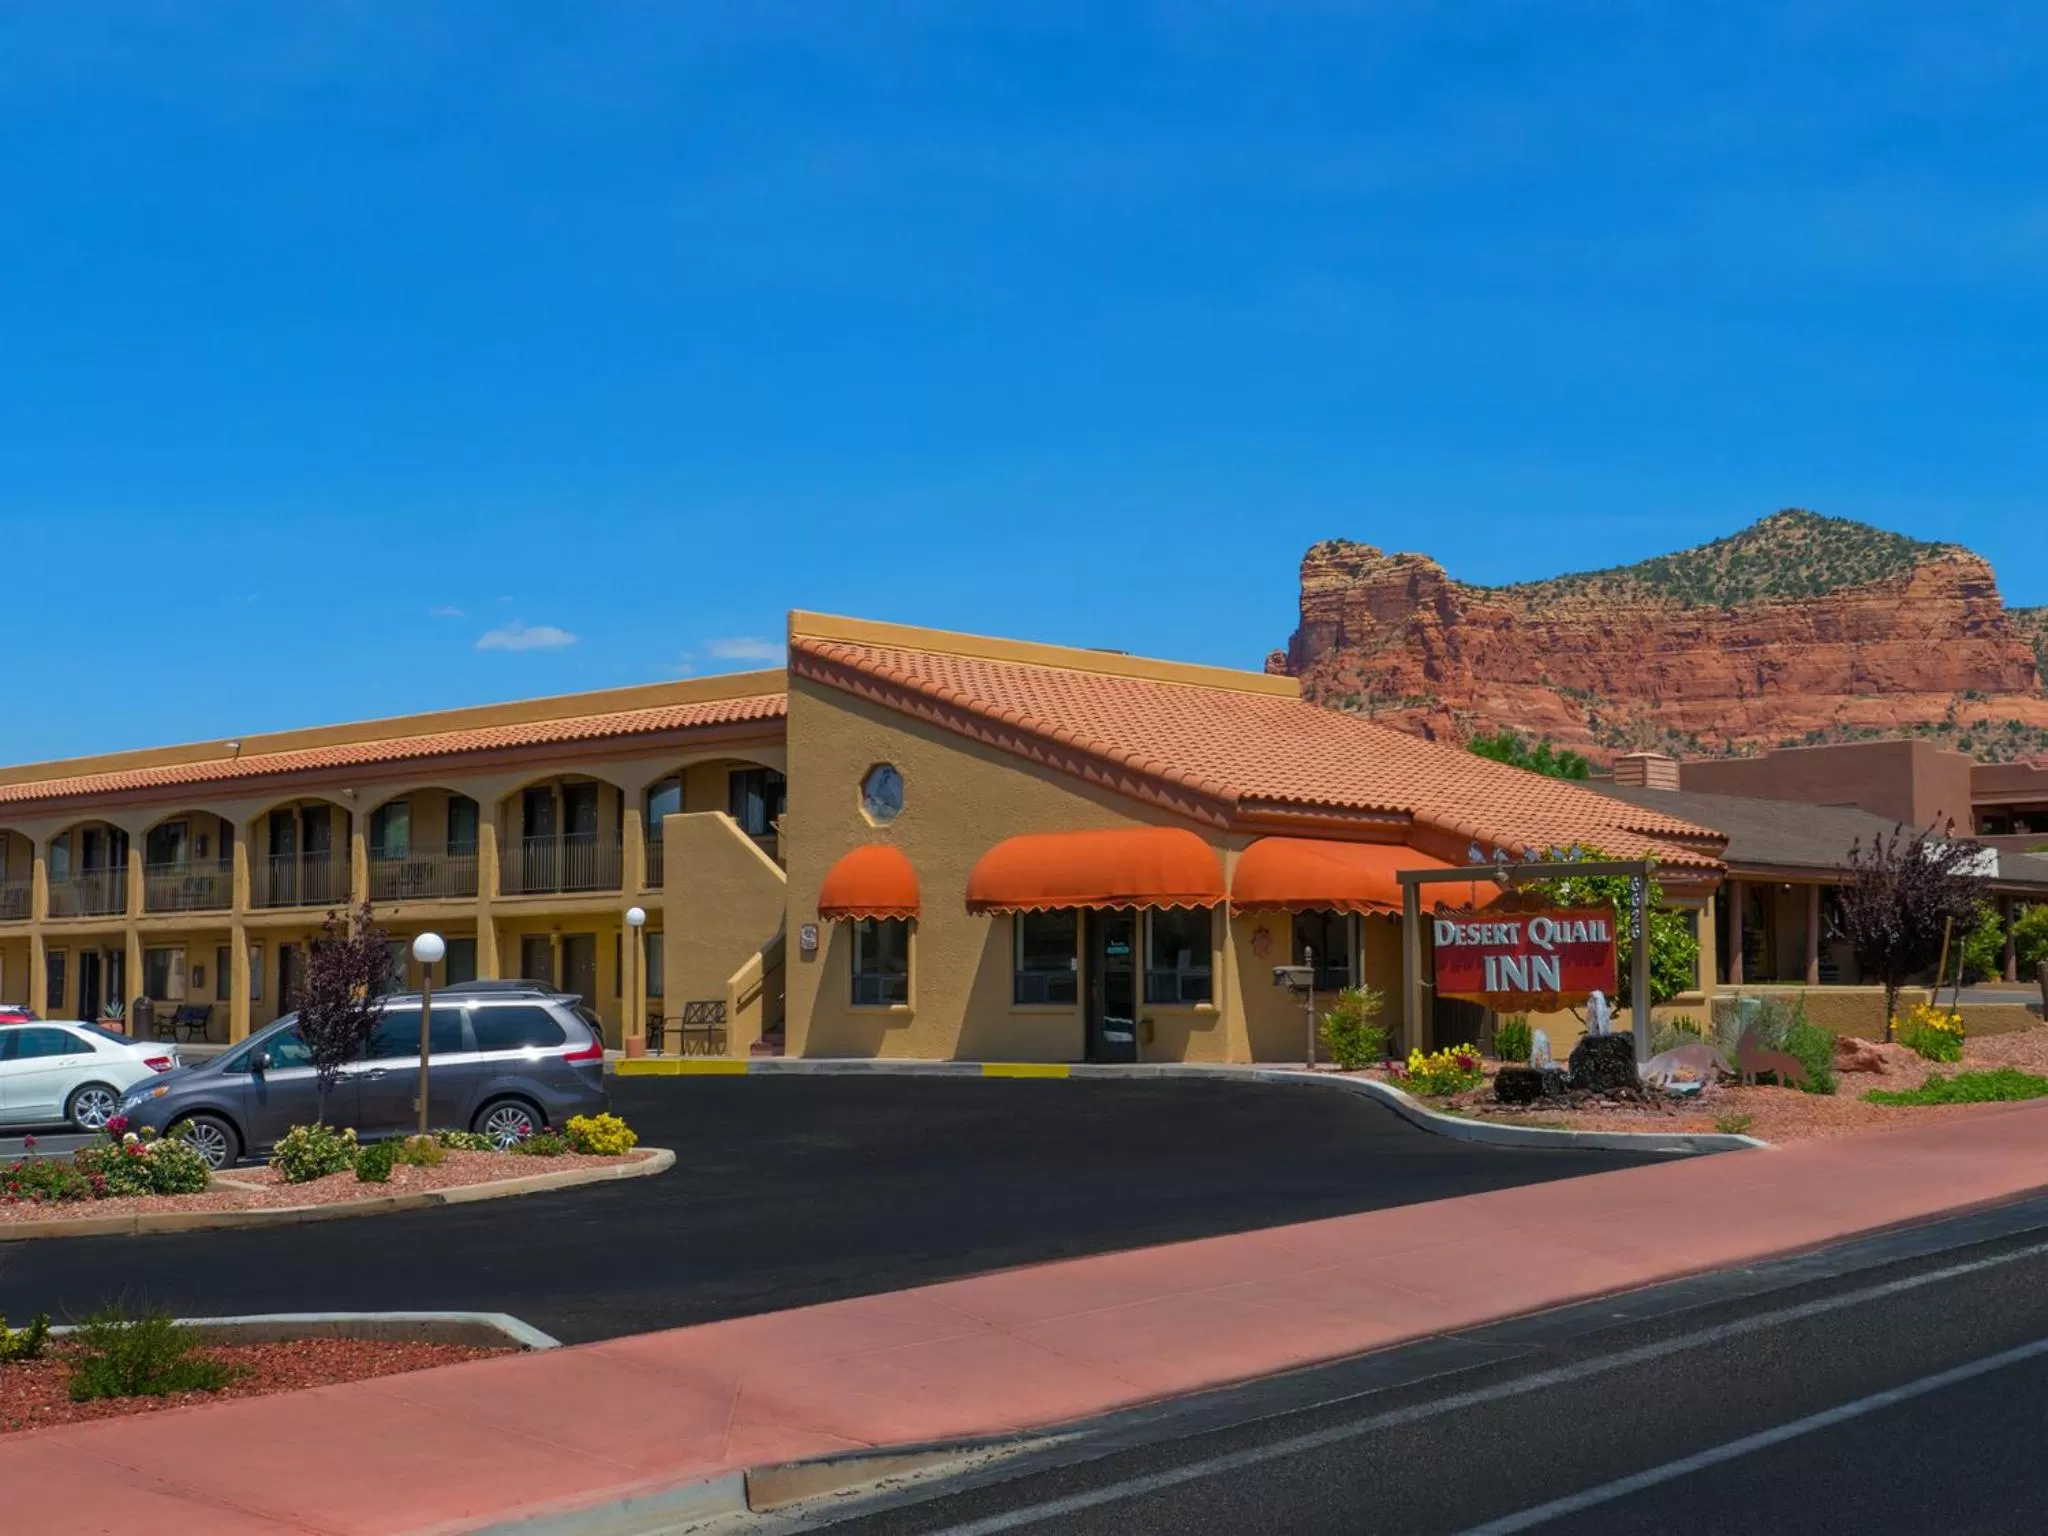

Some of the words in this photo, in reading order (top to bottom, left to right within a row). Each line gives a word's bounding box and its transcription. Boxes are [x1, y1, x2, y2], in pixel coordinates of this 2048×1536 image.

[1434, 919, 1521, 946] DESERT
[1528, 917, 1611, 950] QUAIL
[1484, 955, 1561, 992] INN
